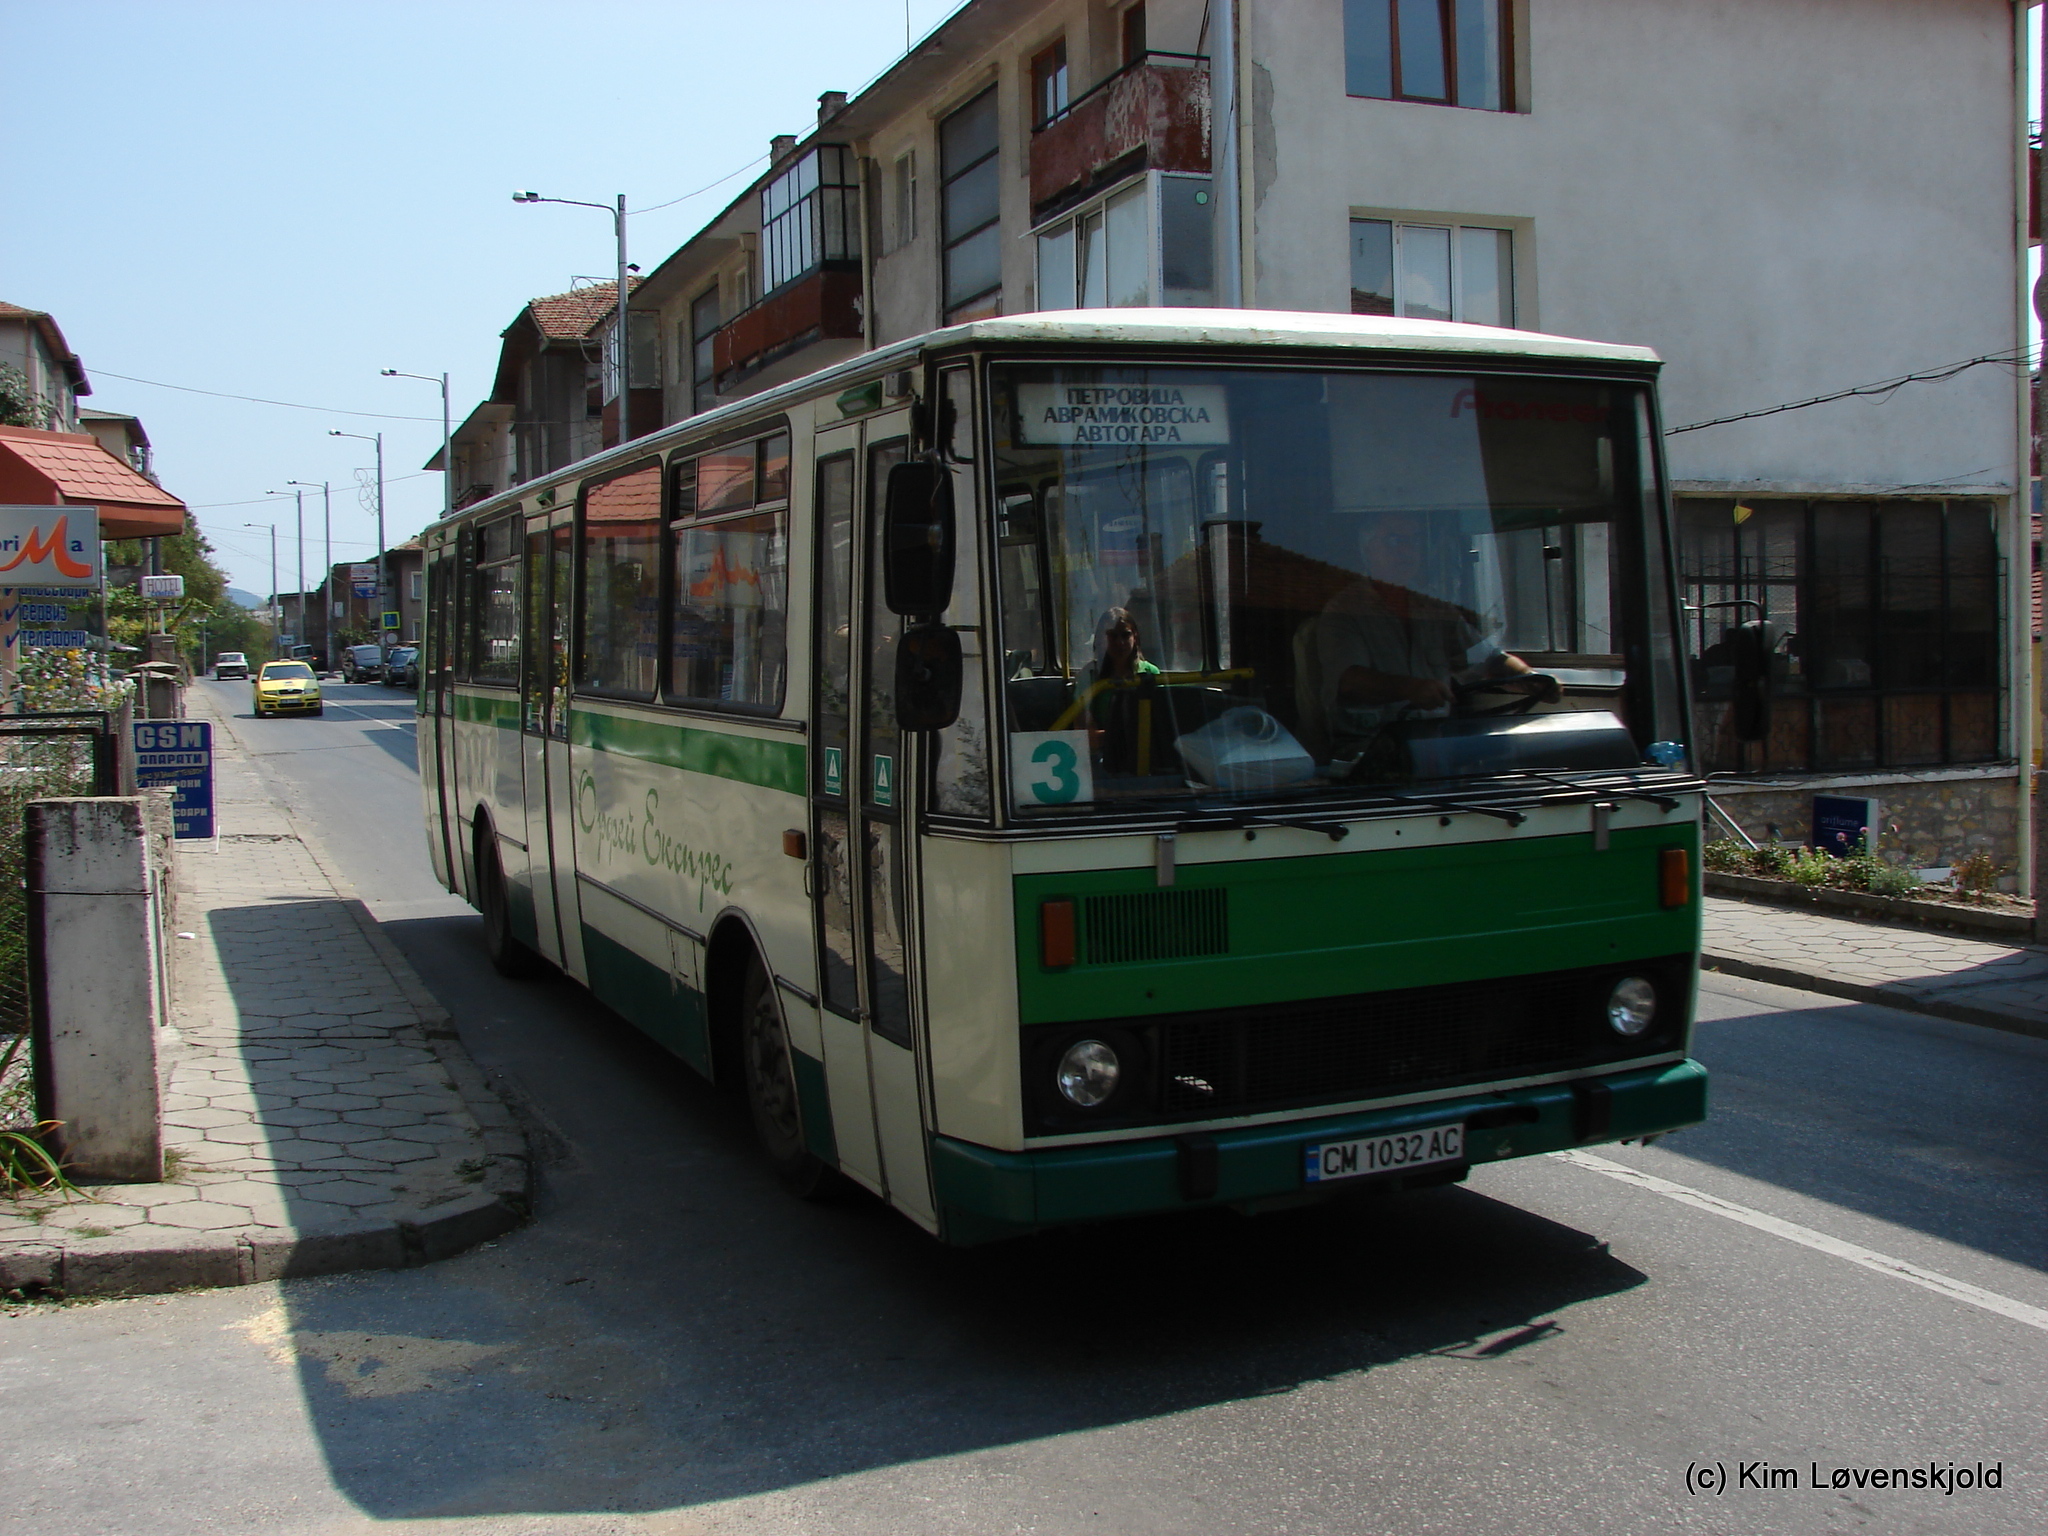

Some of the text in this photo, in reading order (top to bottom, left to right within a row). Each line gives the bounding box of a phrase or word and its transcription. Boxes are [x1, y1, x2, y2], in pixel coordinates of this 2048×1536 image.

[1067, 388, 1185, 405] ПЕТРОВИЦА
[1044, 406, 1211, 424] АВРАМИКОВСКА
[1075, 425, 1182, 442] АВТОГАРА
[0, 515, 93, 578] riMa
[147, 578, 181, 592] HOTEL
[22, 604, 68, 623] сервиз
[21, 630, 86, 648] телефони
[137, 725, 202, 749] GSM
[1031, 740, 1080, 804] 3
[173, 808, 208, 817] СОАРИ
[642, 788, 734, 913] Експрес
[1323, 1127, 1459, 1175] CM 1032 AC
